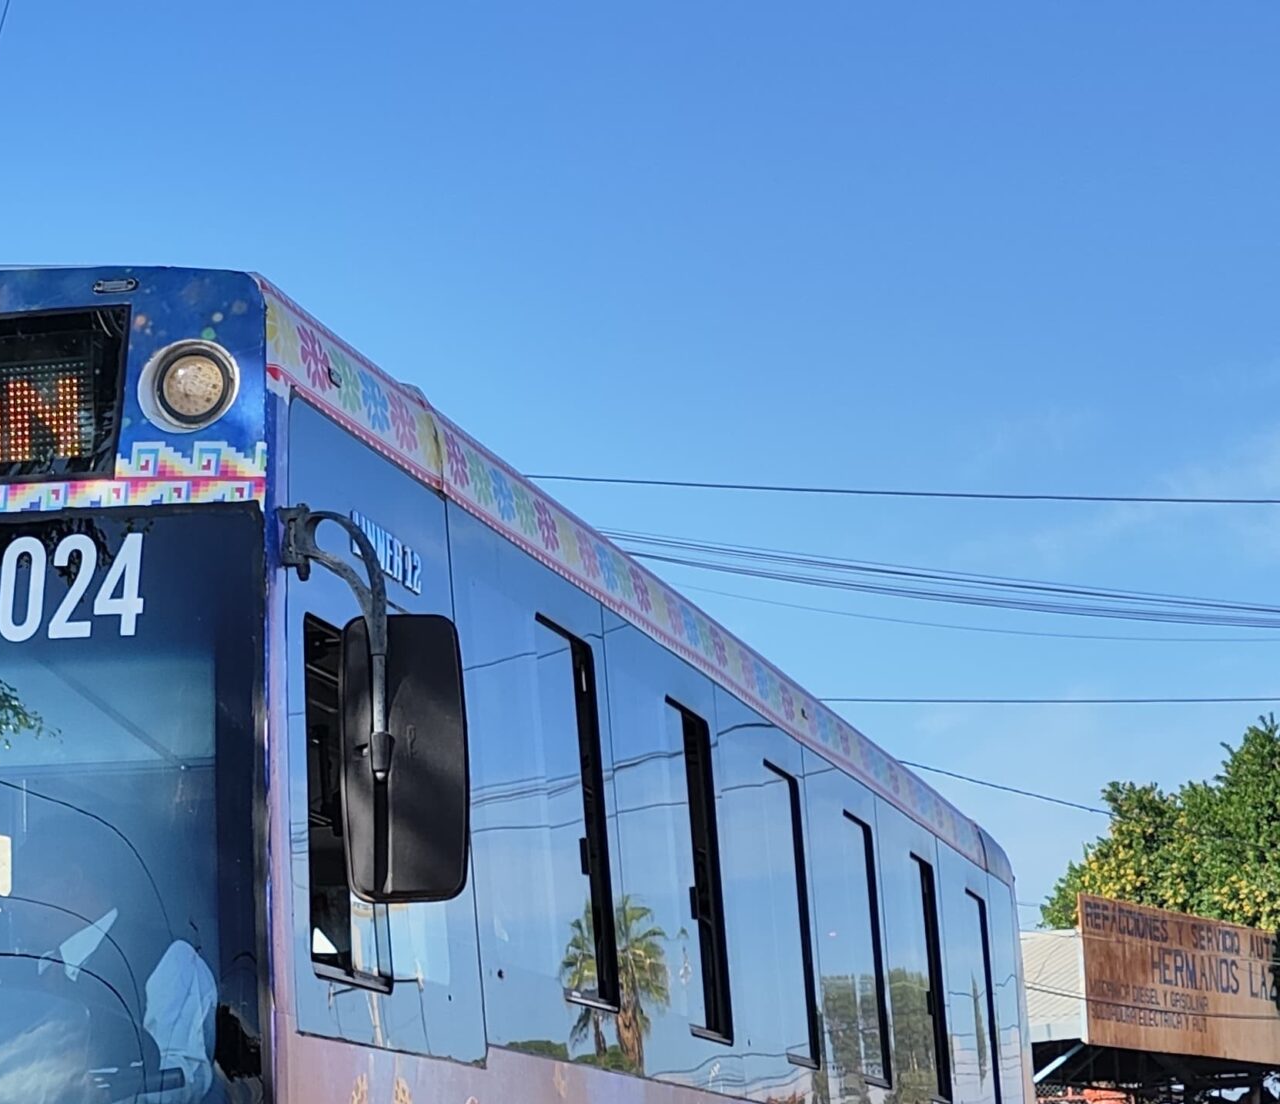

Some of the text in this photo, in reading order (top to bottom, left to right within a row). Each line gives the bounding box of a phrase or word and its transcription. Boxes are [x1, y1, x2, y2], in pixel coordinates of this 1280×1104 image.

[1084, 901, 1170, 944] REFACCIONES
[1177, 920, 1184, 947] Y
[1150, 945, 1240, 995] HERMANOS
[1170, 990, 1209, 1013] GASOLINA
[1138, 1009, 1183, 1032] ELECTRICA
